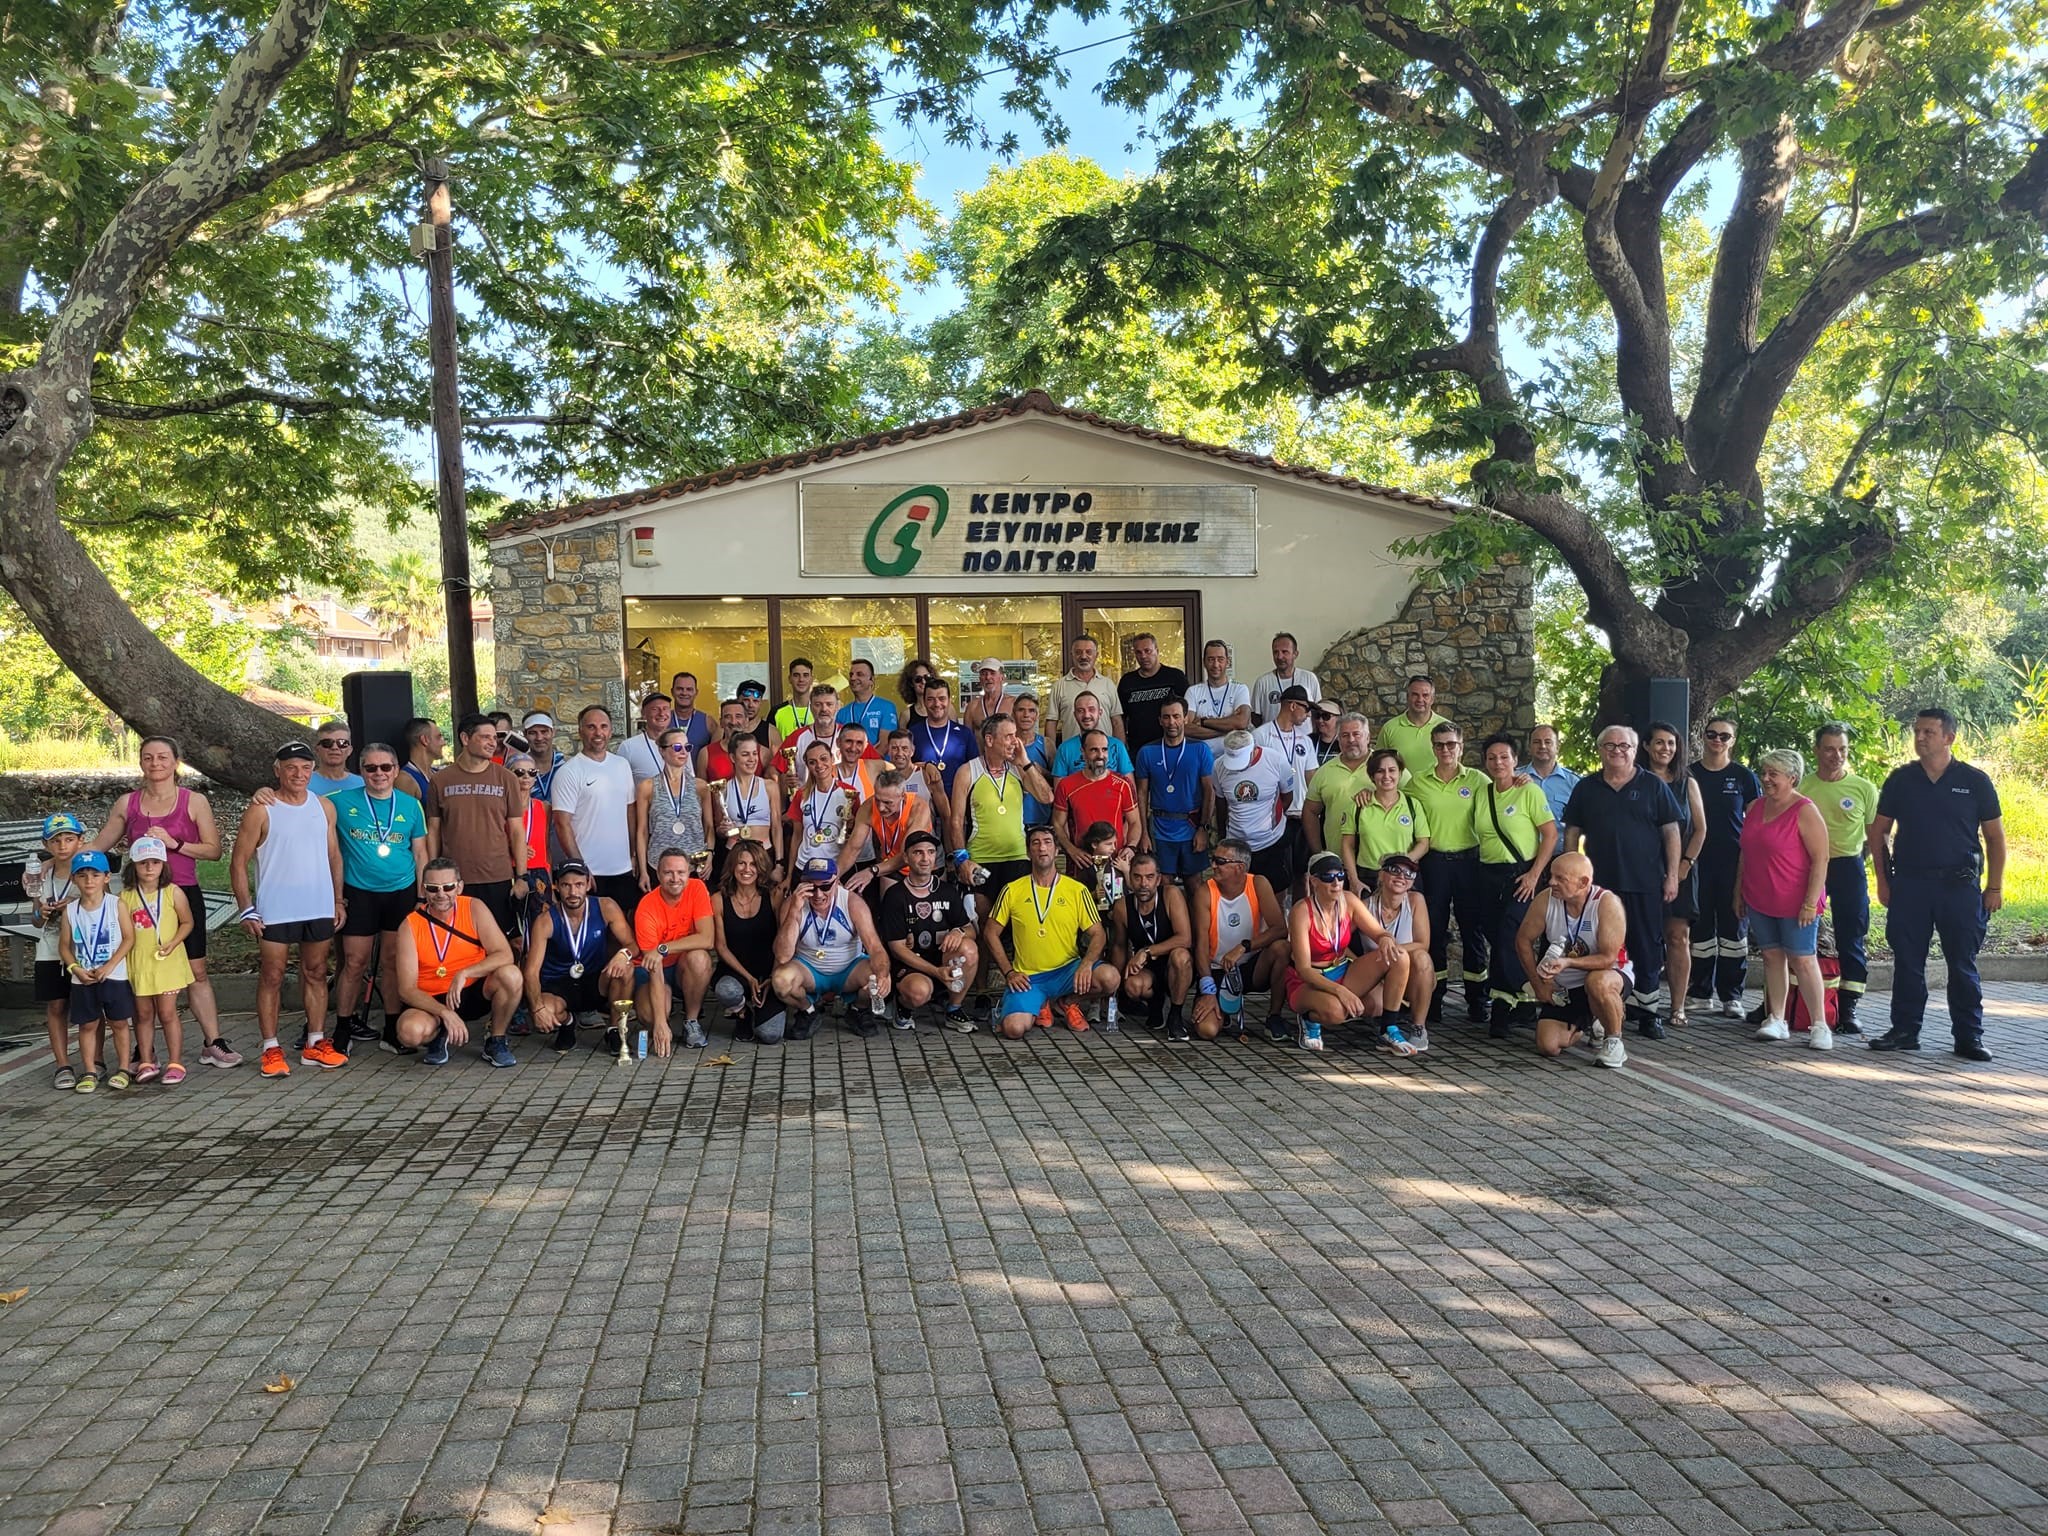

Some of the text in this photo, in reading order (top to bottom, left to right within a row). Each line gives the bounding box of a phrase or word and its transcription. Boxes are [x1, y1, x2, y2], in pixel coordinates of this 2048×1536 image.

[970, 492, 1092, 514] ΚΕΝΤΡΟ
[966, 521, 1200, 543] ΕΞΥΠΗΡΕΤΗΣΗΣ
[962, 549, 1097, 571] ΠΟΛΙΤΩΝ
[472, 783, 505, 797] JEANS
